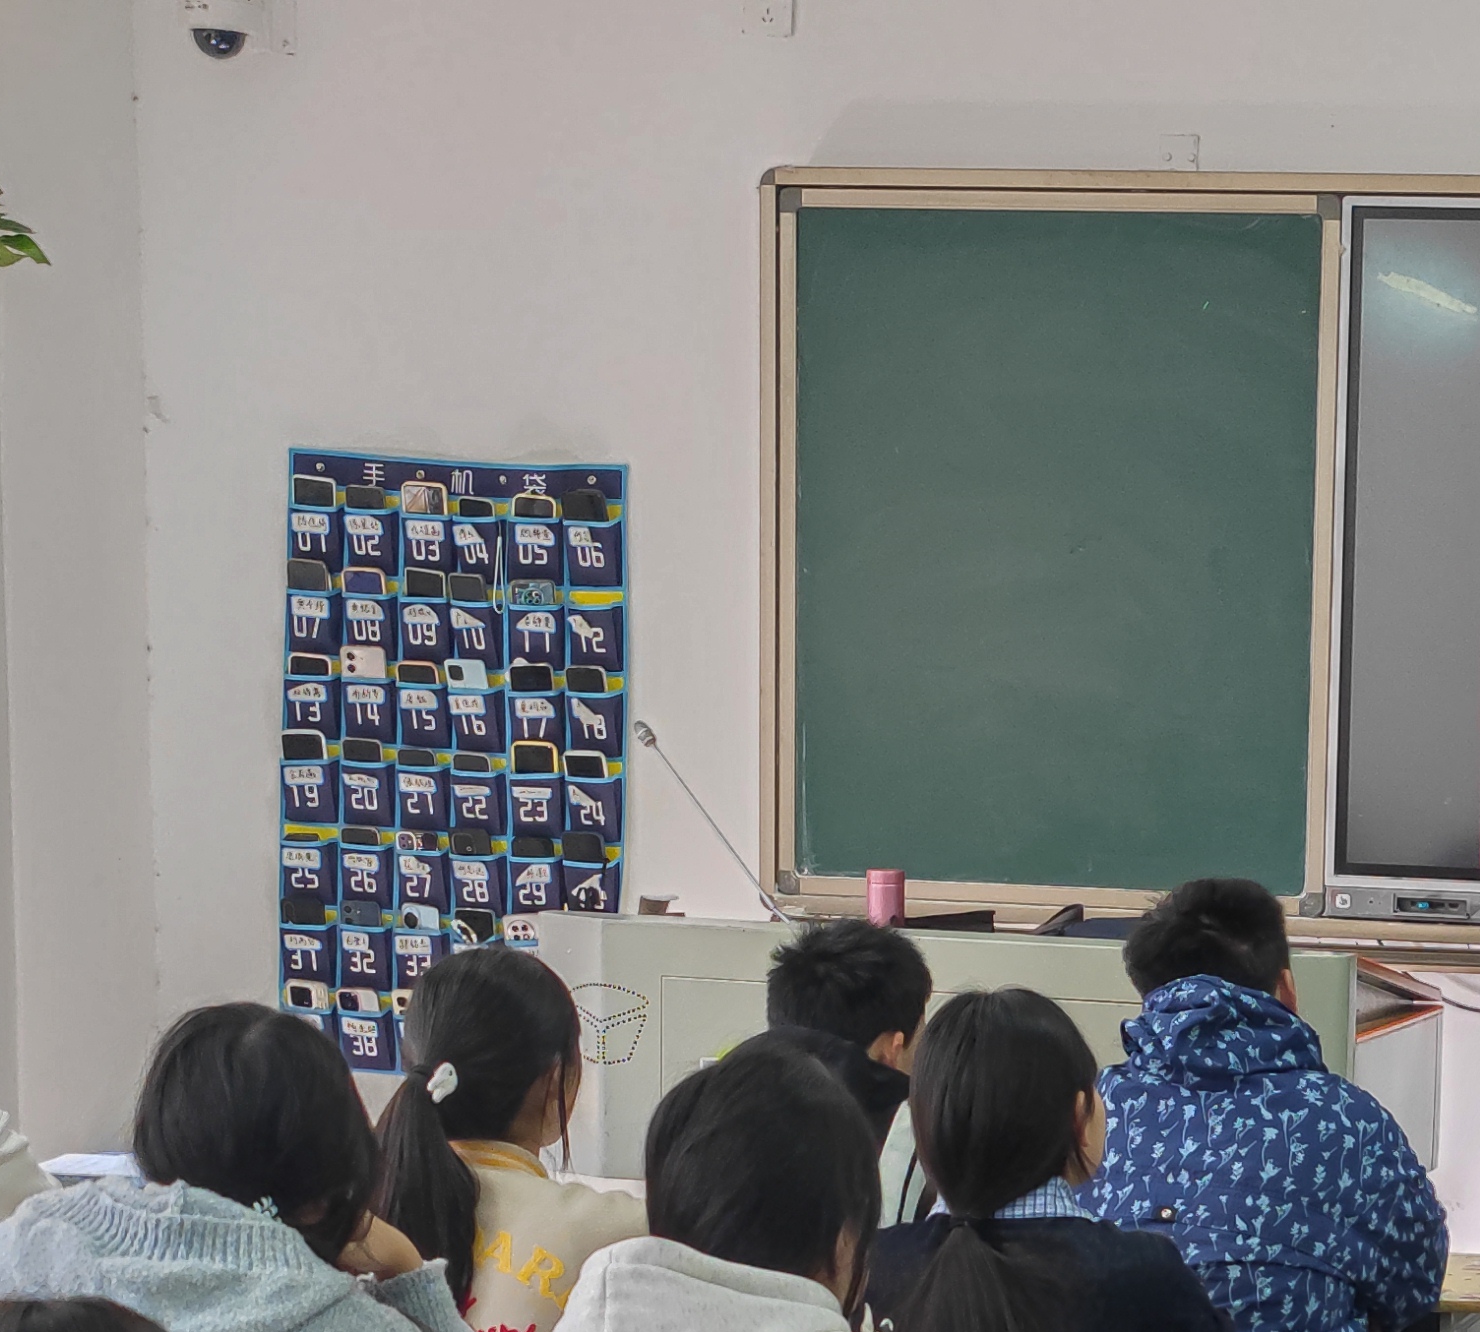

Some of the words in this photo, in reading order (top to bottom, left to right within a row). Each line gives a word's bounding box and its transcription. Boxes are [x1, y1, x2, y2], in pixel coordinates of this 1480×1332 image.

[297, 532, 327, 553] 01
[353, 535, 381, 556] 02
[411, 540, 440, 561] 03
[464, 543, 488, 564] 04
[519, 544, 548, 565] 05
[578, 542, 605, 568] 06
[293, 616, 320, 639] 07
[353, 620, 380, 642] 08
[408, 624, 437, 645] 09
[463, 628, 486, 650] 10
[524, 631, 550, 653] 11
[581, 627, 606, 653] 12
[296, 701, 321, 722] 13
[356, 703, 380, 726] 14
[412, 709, 436, 731] 15
[462, 714, 486, 735] 16
[583, 715, 607, 739] 18
[290, 785, 319, 808] 19
[350, 785, 378, 811] 20
[407, 792, 434, 815] 21
[462, 796, 489, 820] 22
[519, 799, 548, 822] 23
[580, 801, 606, 826] 24
[291, 868, 319, 888] 25
[350, 868, 377, 893] 26
[406, 875, 431, 898] 27
[462, 880, 489, 902] 28
[519, 882, 546, 905] 29
[291, 949, 317, 971] 31
[349, 949, 377, 974] 32
[349, 1034, 378, 1057] 38
